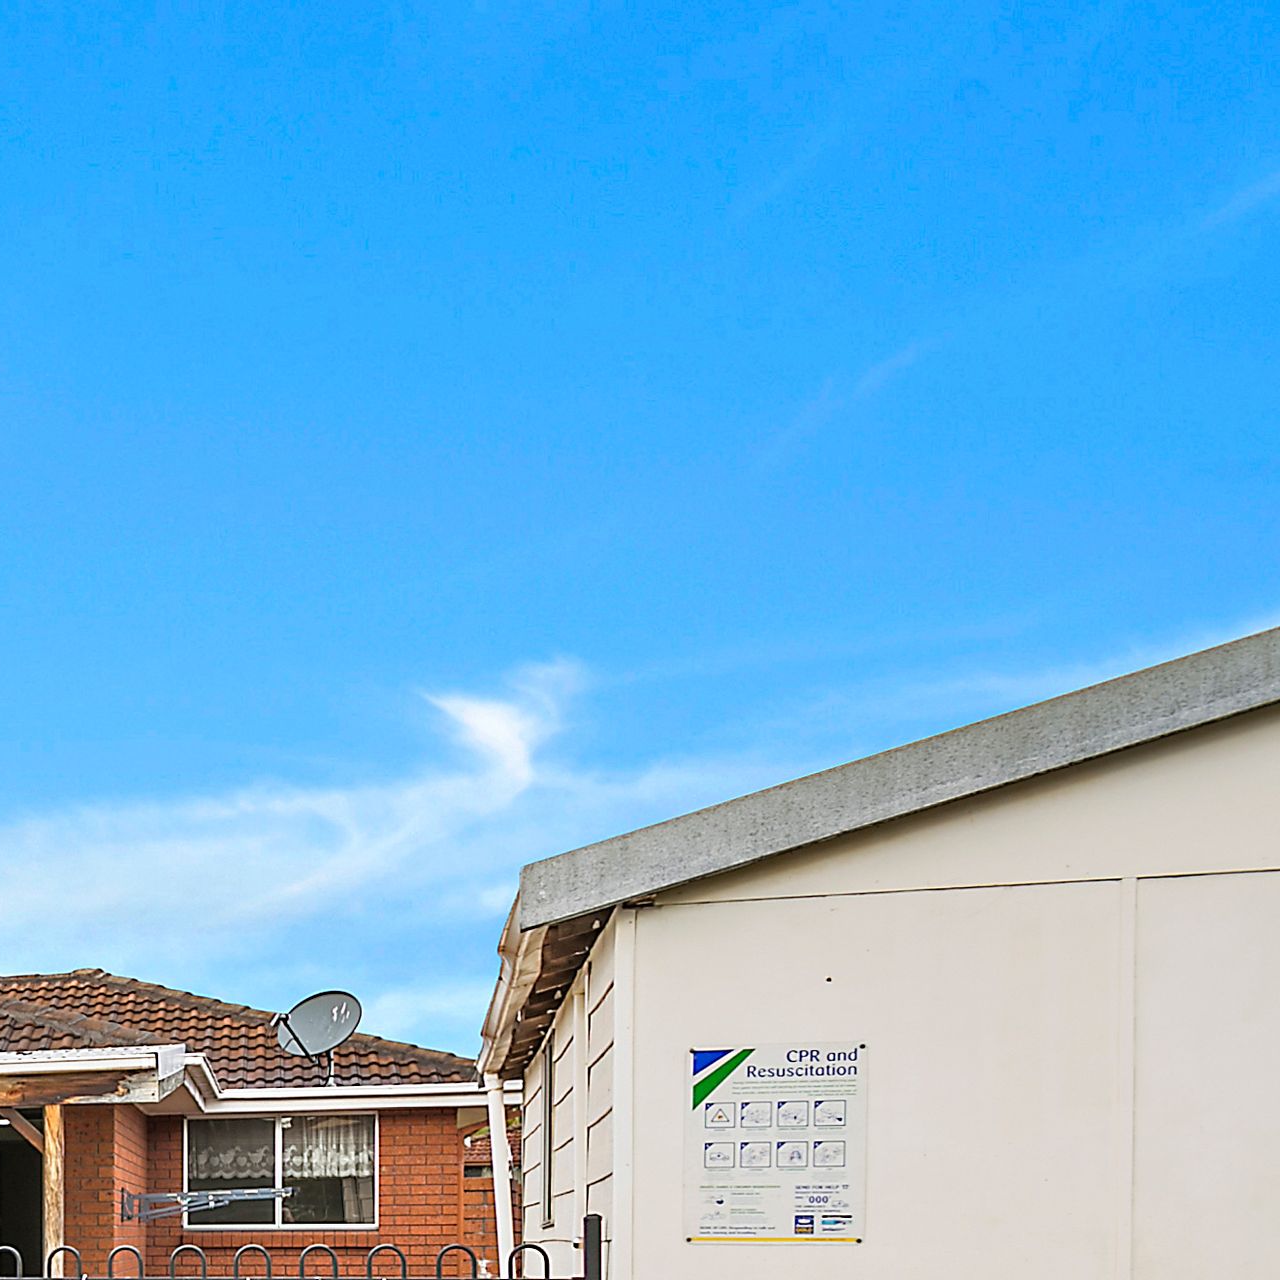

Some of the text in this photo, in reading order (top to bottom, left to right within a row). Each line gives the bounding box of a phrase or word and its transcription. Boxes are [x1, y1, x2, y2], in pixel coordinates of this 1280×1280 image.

[786, 1048, 858, 1062] CPR and
[747, 1064, 858, 1077] Resuscitation
